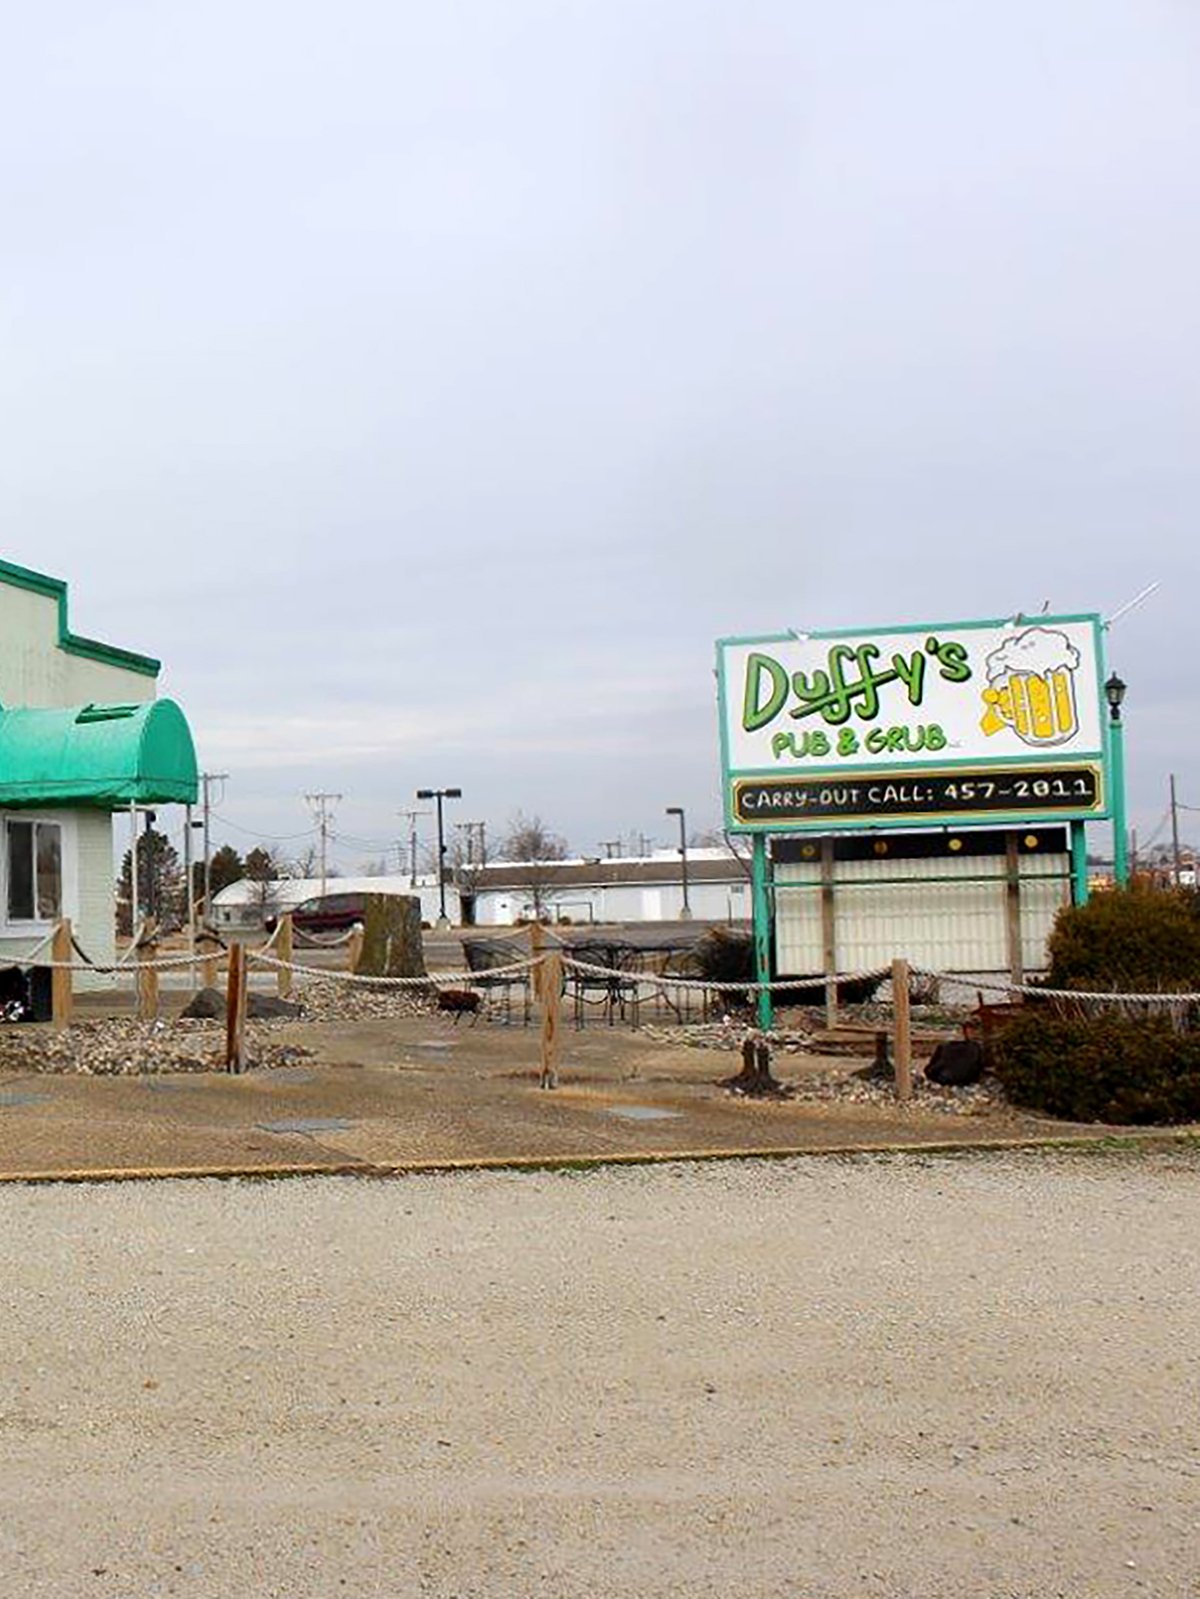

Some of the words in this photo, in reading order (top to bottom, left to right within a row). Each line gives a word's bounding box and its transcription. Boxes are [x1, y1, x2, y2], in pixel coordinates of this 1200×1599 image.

[743, 637, 971, 731] Duffy's
[771, 731, 831, 760] PUB
[836, 728, 860, 757] &
[865, 723, 947, 754] GRUB
[741, 788, 859, 810] CARRY-OUT
[868, 785, 934, 803] CALL:
